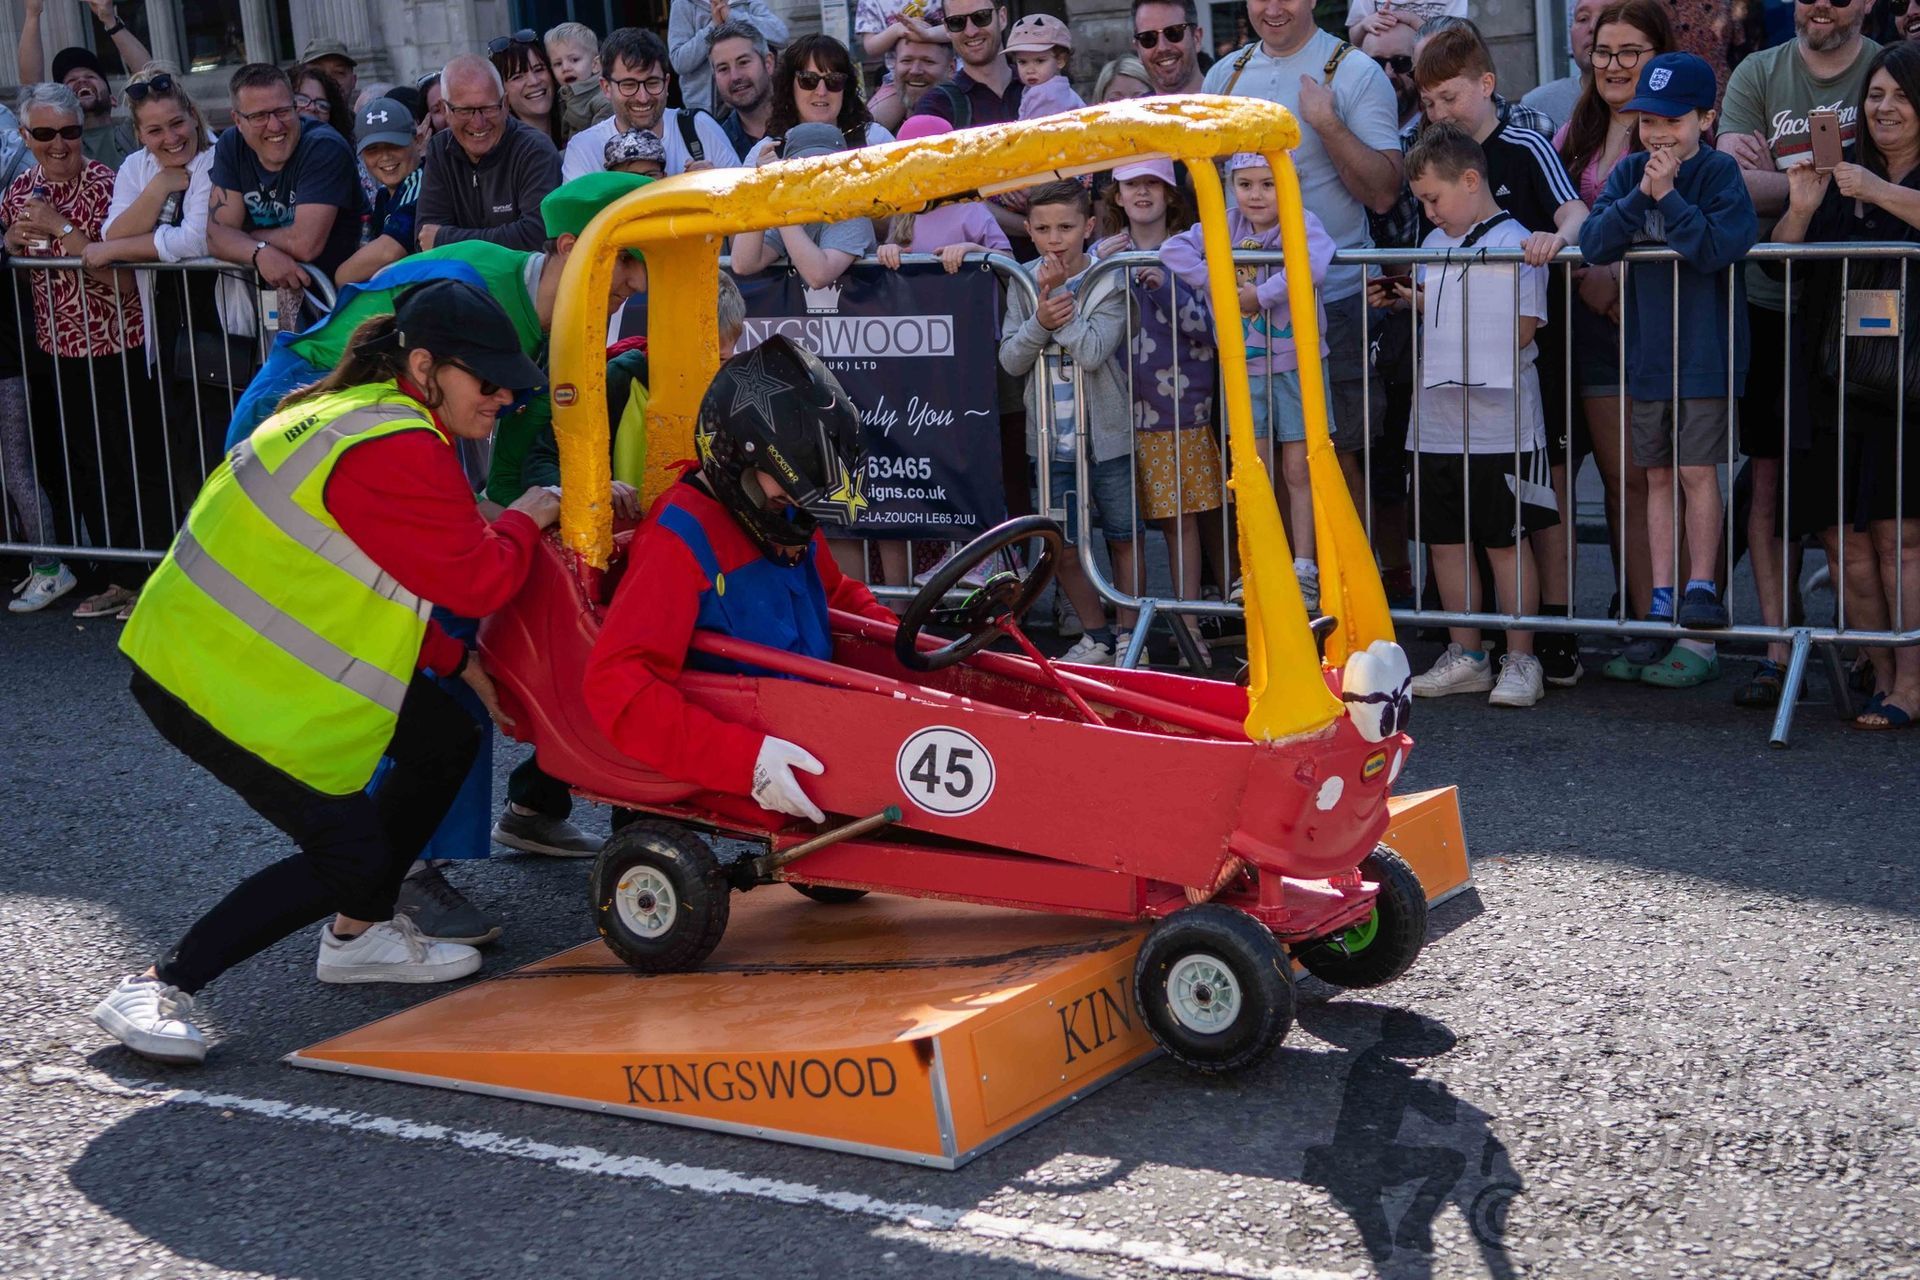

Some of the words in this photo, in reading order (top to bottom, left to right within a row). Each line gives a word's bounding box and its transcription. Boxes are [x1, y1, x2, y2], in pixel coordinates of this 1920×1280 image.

[733, 319, 952, 355] NGSWOOD
[854, 361, 877, 370] LTD
[860, 395, 898, 437] uly
[907, 395, 954, 436] You
[926, 512, 952, 524] LE65
[954, 513, 976, 525] 2UU
[909, 743, 974, 798] 45
[622, 1057, 897, 1104] KINGSWOOD
